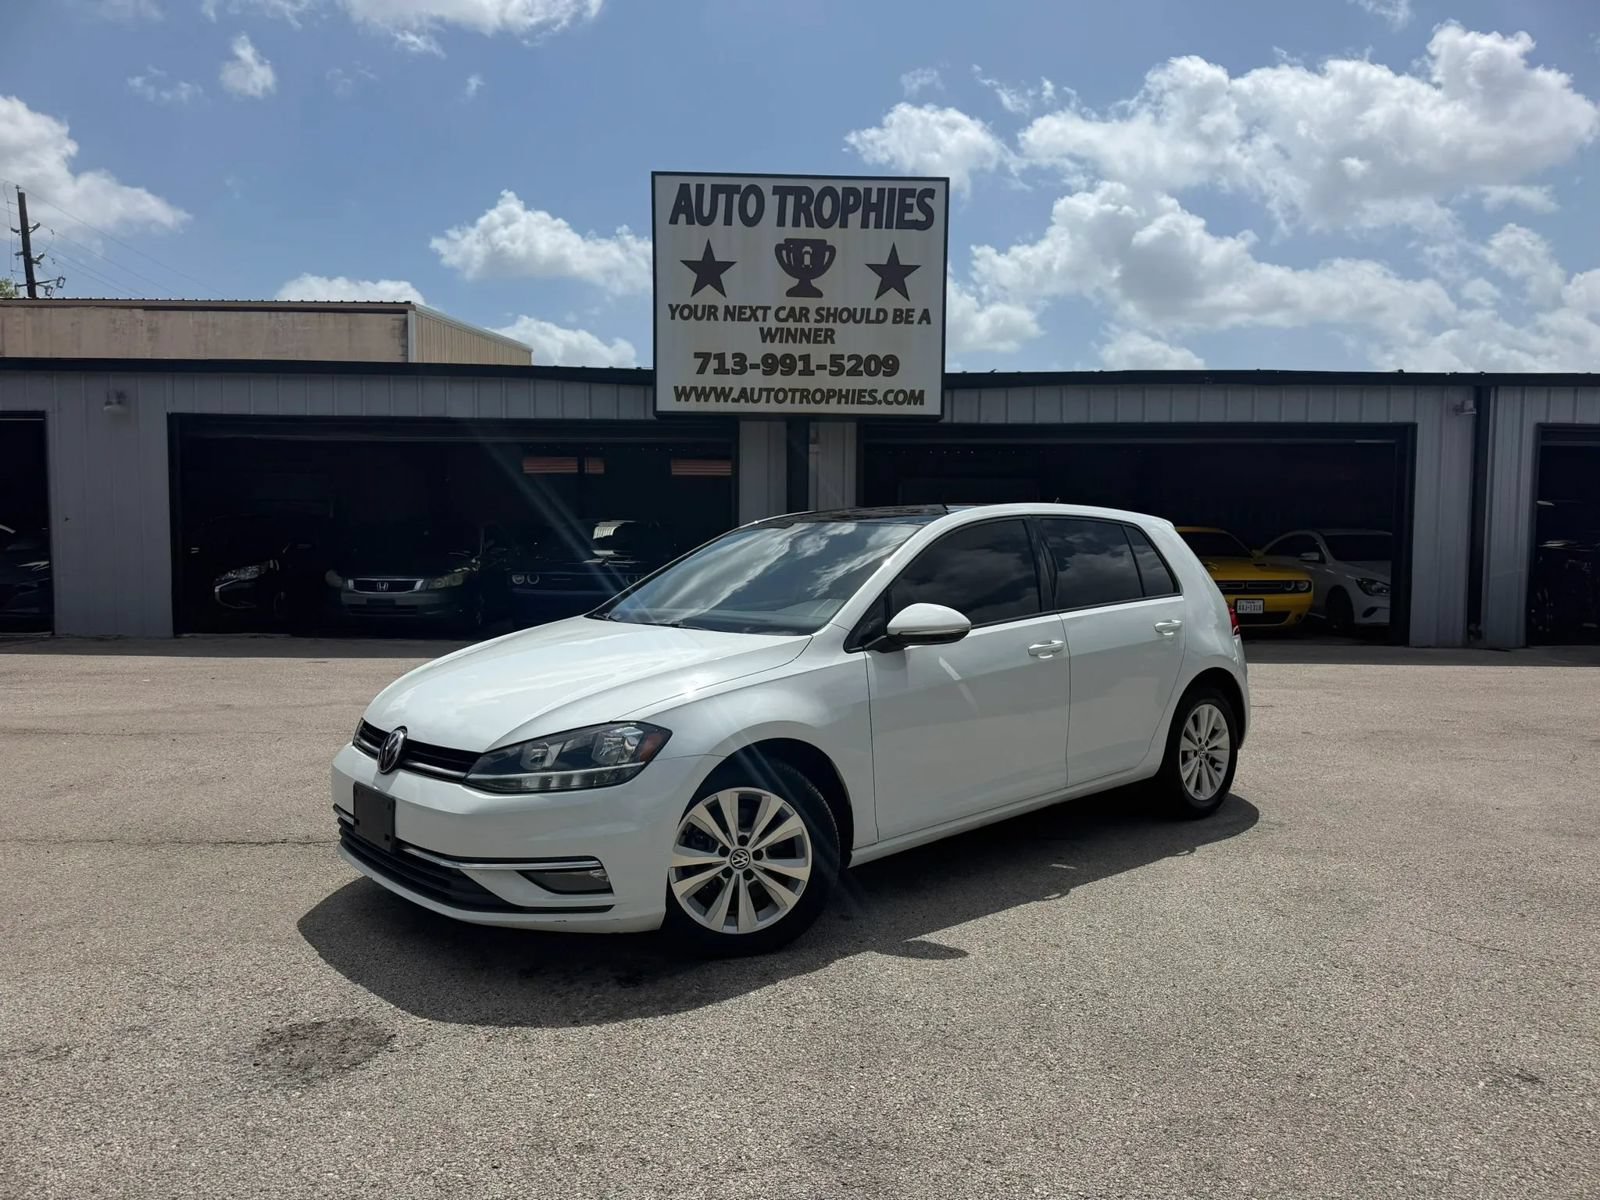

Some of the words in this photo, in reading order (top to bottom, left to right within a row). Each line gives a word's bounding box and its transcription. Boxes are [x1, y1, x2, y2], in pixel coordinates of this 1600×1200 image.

[669, 183, 765, 227] AUTO
[772, 185, 936, 231] TROPHIES
[668, 304, 718, 321] YOUR
[723, 305, 771, 322] NEXT
[774, 306, 810, 323] CAR
[814, 307, 888, 325] SHOULD
[891, 308, 915, 325] BE
[918, 308, 931, 325] A
[759, 327, 836, 345] WINNER
[694, 352, 900, 377] 713-991-5209
[673, 386, 924, 405] WWW.AUTOTROPHIES.COM
